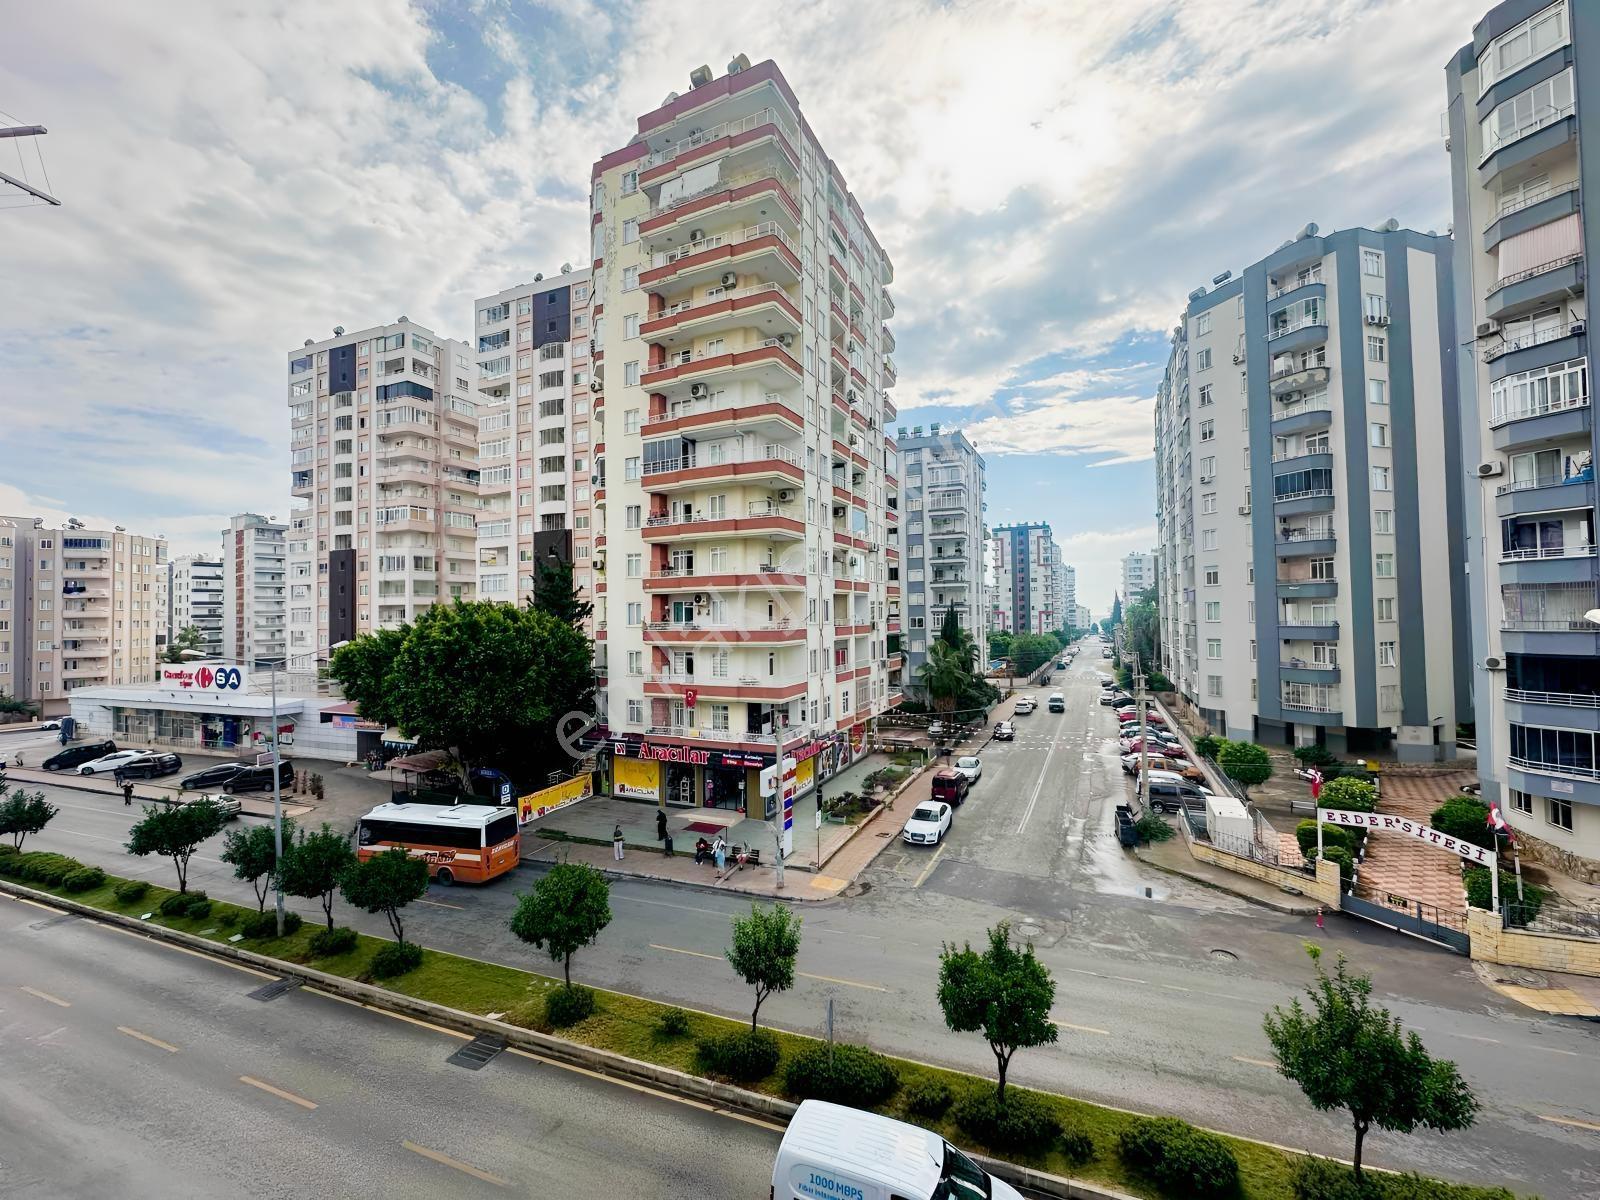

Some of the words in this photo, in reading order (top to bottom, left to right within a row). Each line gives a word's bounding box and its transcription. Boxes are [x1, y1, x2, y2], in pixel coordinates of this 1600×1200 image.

[216, 671, 239, 686] SA
[638, 742, 710, 765] Aracılar
[809, 1173, 834, 1191] 1000
[836, 1182, 863, 1200] MBPS
